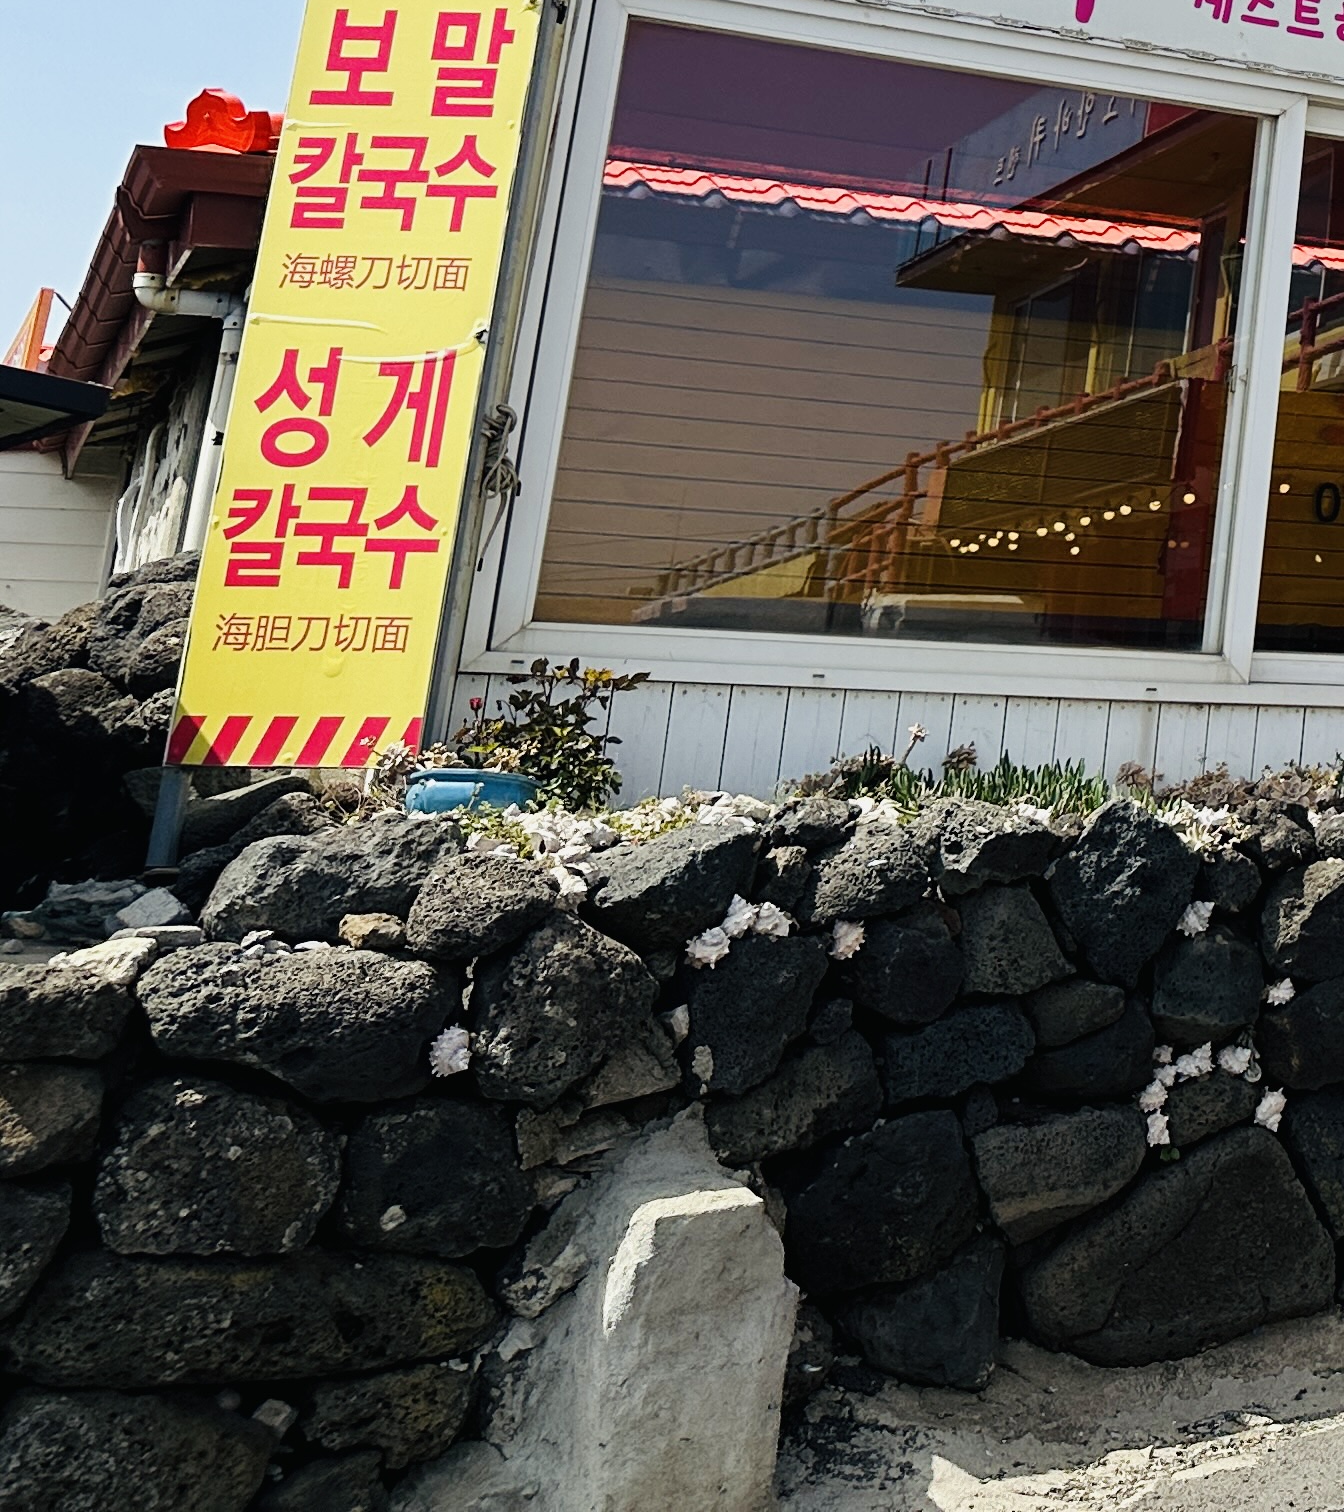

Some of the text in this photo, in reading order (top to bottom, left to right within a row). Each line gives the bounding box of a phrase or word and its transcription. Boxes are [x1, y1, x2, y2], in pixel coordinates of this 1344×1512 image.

[309, 8, 516, 117] 보말
[288, 132, 498, 233] 칼국수
[279, 252, 471, 292] 海螺刀切面
[255, 347, 457, 469] 성게
[224, 484, 440, 590] 칼국수
[214, 613, 412, 654] 海胆刀切面
